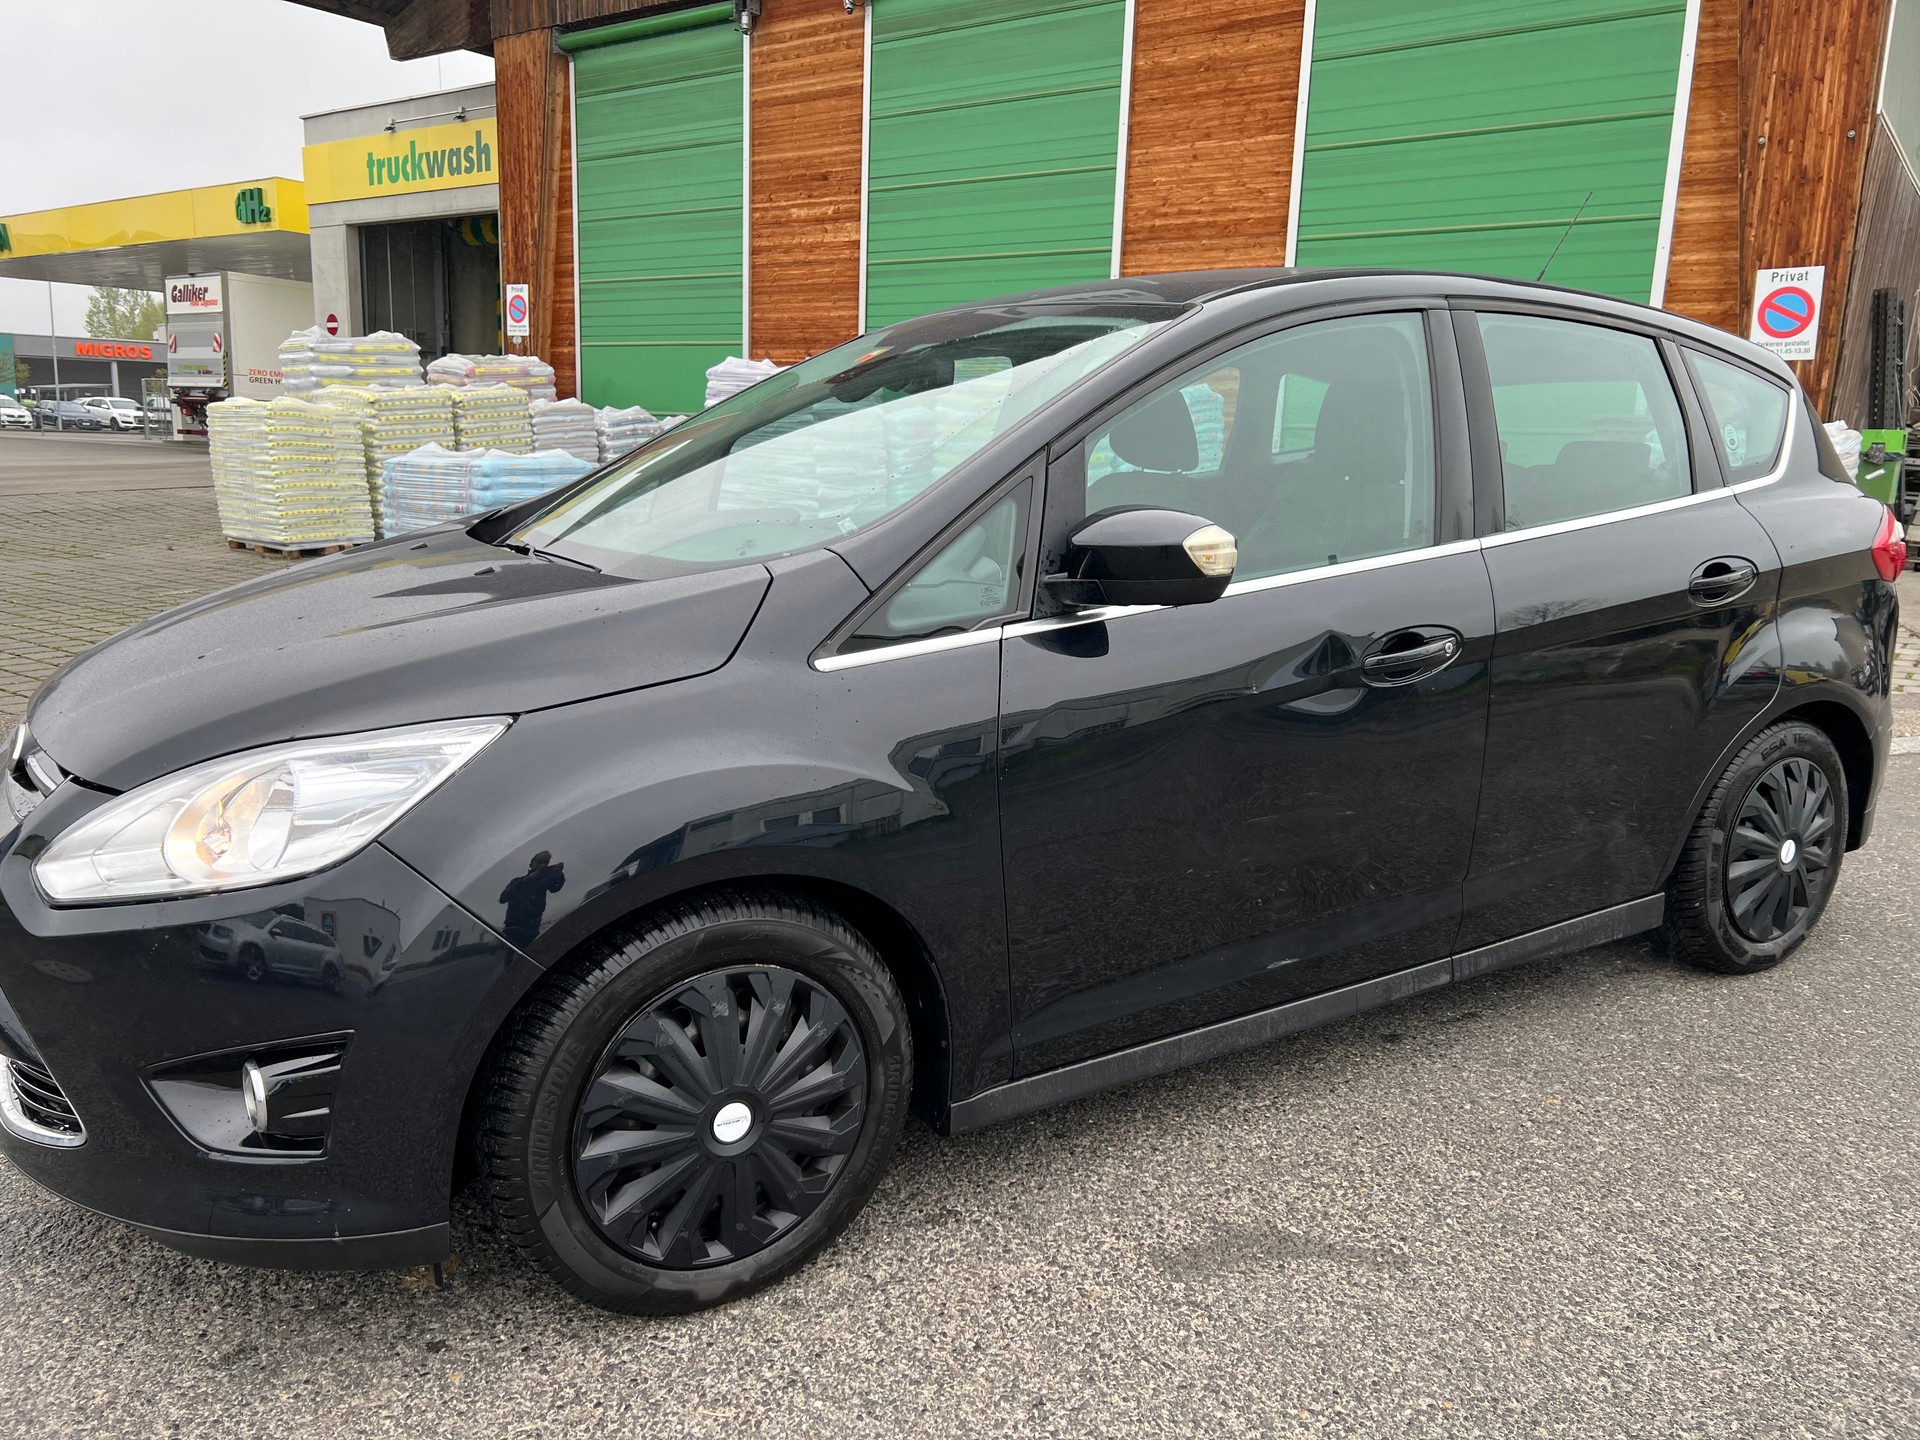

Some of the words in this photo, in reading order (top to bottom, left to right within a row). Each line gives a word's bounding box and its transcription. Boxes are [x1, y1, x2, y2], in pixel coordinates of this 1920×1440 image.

[366, 130, 491, 186] truckwash
[1771, 271, 1809, 283] Privat
[171, 284, 208, 303] Galliker
[75, 342, 153, 360] MIGROS
[248, 369, 268, 377] ZERO
[248, 376, 274, 385] GREEN
[531, 1038, 583, 1191] BRIDGESTONE
